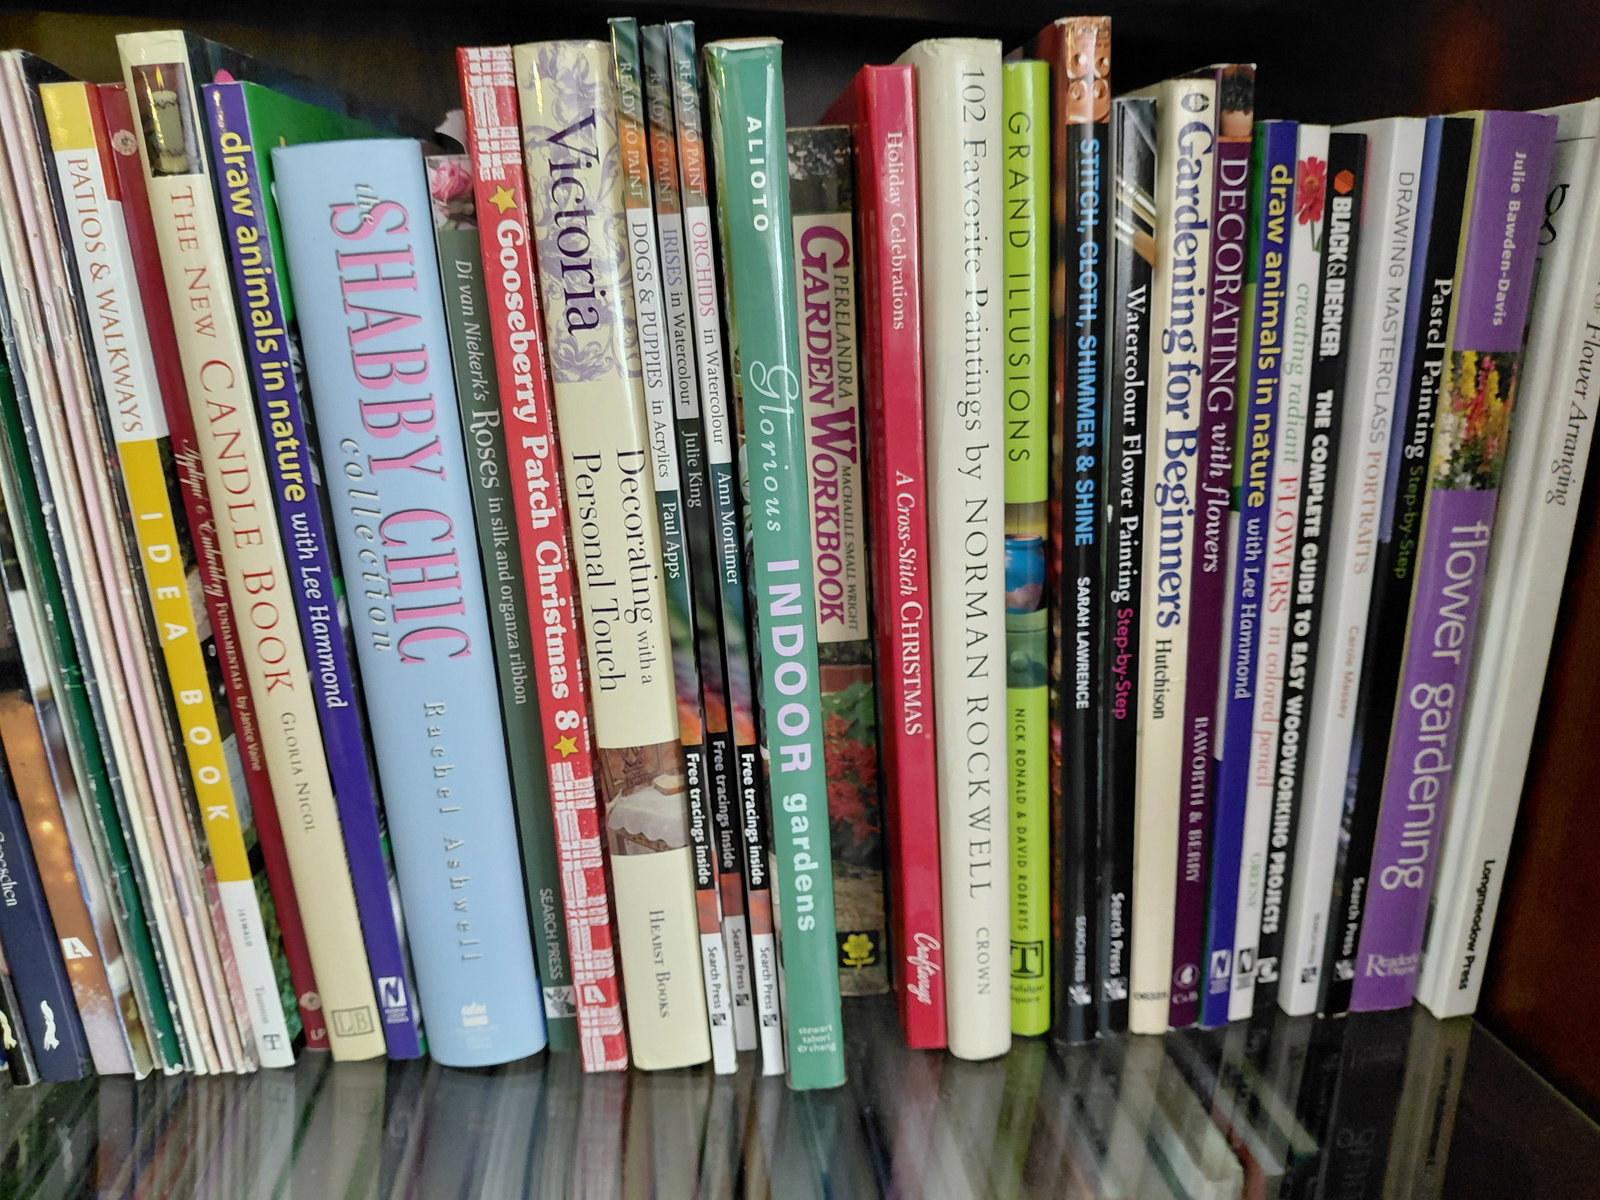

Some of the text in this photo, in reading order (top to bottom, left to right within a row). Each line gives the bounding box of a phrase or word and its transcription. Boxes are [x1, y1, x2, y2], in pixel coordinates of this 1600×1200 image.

[546, 109, 607, 335] Victoria
[619, 62, 643, 199] READY TO PAINT
[747, 116, 769, 232] ALIOTO
[885, 132, 907, 330] Holiday Celebrations
[1493, 152, 1526, 326] Julie Bawden-Davis
[68, 157, 143, 433] PATIOS & WALKWAYS
[497, 220, 537, 424] Gooseberry
[632, 223, 670, 478] DOGS & PUPPIES in Acrylics
[662, 229, 691, 406] IRISES in Watercolour
[692, 222, 724, 444] ORCHIDS in Watercolour
[834, 275, 853, 399] PERELANDRA
[1008, 111, 1031, 462] GRAND ILLUSIONS
[1075, 138, 1099, 546] STITCH, CLOTH, SHIMMER & SHINE
[1203, 158, 1248, 573] DECORATING with flowers
[1355, 173, 1414, 575] DRAWING MASTERCLASS PORTRAITS
[171, 186, 315, 833] THE NEW CANDLE BOOK GLORIA NICOL
[220, 131, 348, 709] draw animals in nature with Lee Hammond
[329, 184, 471, 663] the SHABBY CHIC collection
[454, 260, 526, 704] Di van Niekerk's Roses in silk and organza ribbon
[522, 435, 556, 529] Patch
[682, 431, 702, 508] Julie King
[717, 472, 738, 585] Ann Mortimer
[749, 361, 800, 532] Glorious
[800, 225, 856, 625] GARDEN WORKBOOK
[957, 68, 992, 899] 102 Favorite Paintings by NORMAN ROCKWELL
[1111, 285, 1146, 719] Watercolour Flower Painting Step-by-Step
[1152, 122, 1214, 719] Gardening for Beginners Hutchison
[1393, 278, 1453, 579] Pastel Painting Step-by-Step
[1545, 402, 1588, 507] Arranging
[535, 540, 569, 699] Christmas
[572, 452, 626, 692] Personal Touch
[617, 448, 658, 685] Decorating with a
[662, 502, 681, 579] Paul Apps
[842, 465, 860, 631] MACHAELLE SMALL WRIGHT
[896, 470, 924, 736] A Cross-Stitch CHRISTMAS
[1076, 577, 1091, 709] SARAH LAWRENCE
[1255, 284, 1309, 788] creating radiant FLOWERS in colored pencil
[1432, 520, 1491, 664] flower
[140, 512, 229, 821] IDEA BOOK
[235, 694, 248, 710] by
[767, 559, 818, 931] INDOOR gardens
[1263, 390, 1334, 934] THE COMPLETE GUIDE TO EASY WOODWORKING PROJECTS
[424, 701, 482, 961] Rachel Ashwell
[686, 753, 708, 885] Free tracings inside
[1016, 708, 1028, 931] NICK RONALD & DAVID ROBERTS
[1380, 683, 1455, 890] gardening
[539, 889, 564, 980] SEARCH PRESS
[707, 946, 721, 1017] Search Press
[975, 927, 990, 996] CROWN
[1109, 893, 1125, 975] Search Press
[1458, 860, 1495, 989] Longmeadow Press
